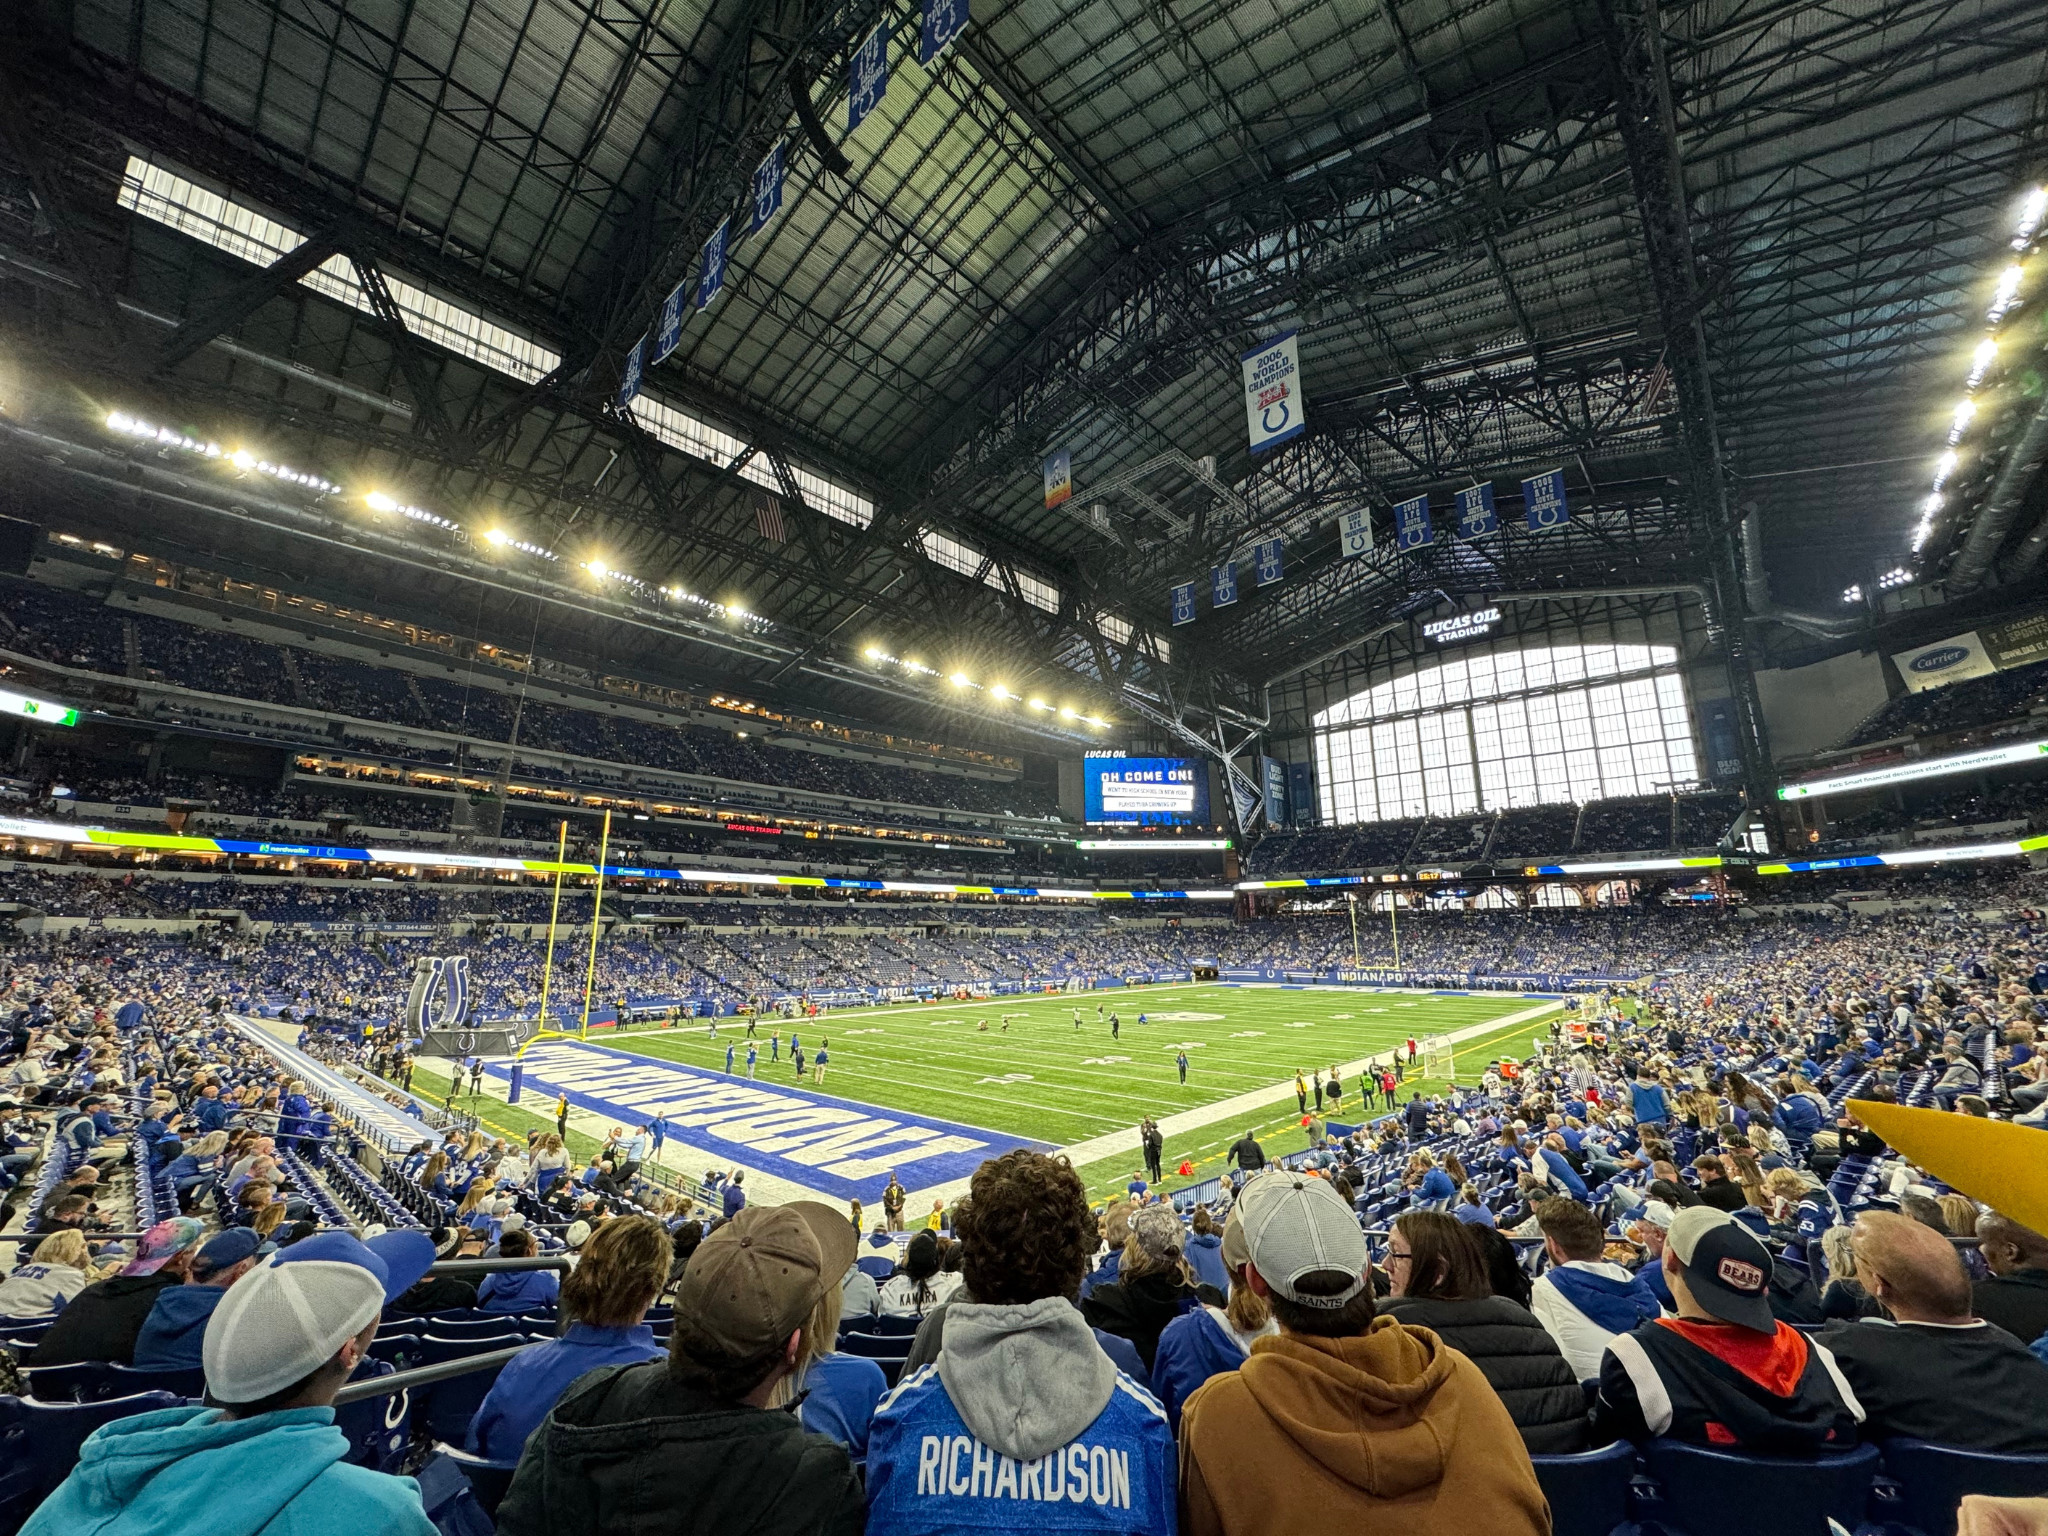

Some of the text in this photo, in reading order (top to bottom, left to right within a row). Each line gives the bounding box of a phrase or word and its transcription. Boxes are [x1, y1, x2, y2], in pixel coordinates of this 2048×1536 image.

[1257, 348, 1282, 369] 2006
[1248, 363, 1295, 393] CHAMPIONS
[1252, 356, 1289, 381] WORLD
[1424, 608, 1501, 636] LUCAS OIL
[1437, 624, 1489, 643] STADIUM
[1917, 650, 1961, 669] Carrier
[1085, 750, 1127, 758] LUCAS OIL
[1717, 759, 1740, 768] BUD
[1892, 769, 1924, 777] decisions
[1962, 753, 2007, 765] NerdWallet
[1101, 770, 1193, 782] OH COME ON!
[270, 846, 309, 855] nerdwallet
[328, 923, 355, 931] TEXT
[1488, 1080, 1498, 1091] 32
[1800, 1220, 1814, 1232] 53
[1723, 1263, 1760, 1285] BEARS
[1300, 1296, 1343, 1308] SAINTS
[918, 1436, 1130, 1510] RICHARDSON
